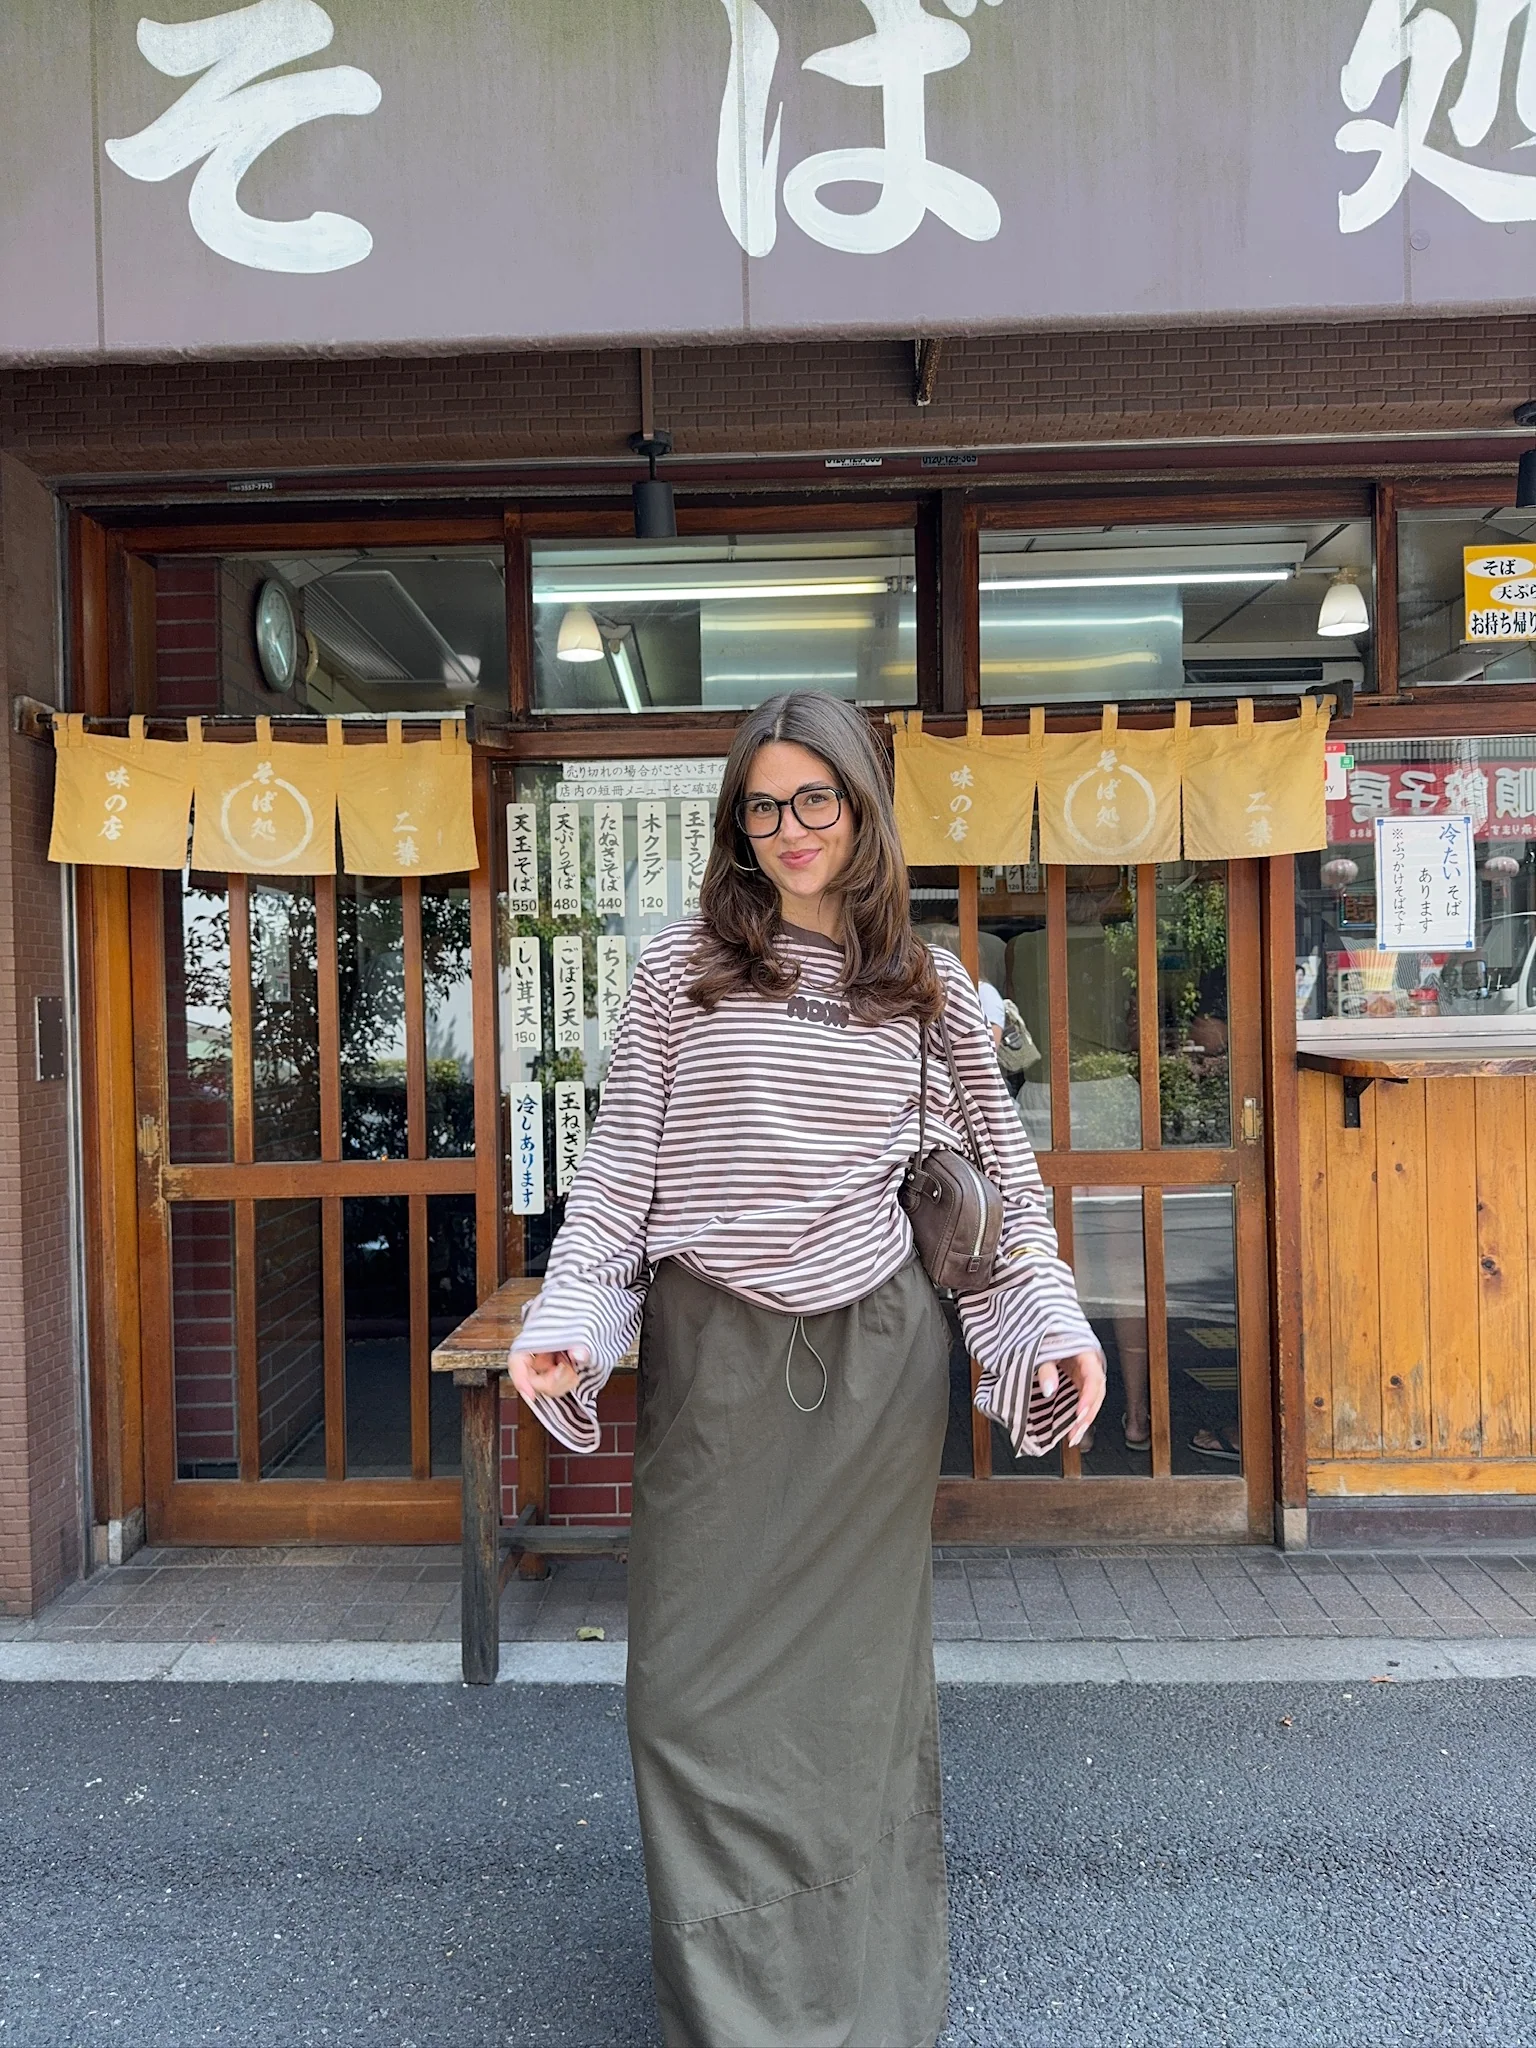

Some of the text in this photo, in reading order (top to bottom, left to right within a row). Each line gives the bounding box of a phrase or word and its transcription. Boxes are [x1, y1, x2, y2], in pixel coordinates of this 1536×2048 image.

[1483, 559, 1516, 576] そば
[97, 765, 130, 841] 味の店
[252, 761, 277, 841] そば処
[944, 764, 974, 841] 味の店
[1096, 749, 1121, 829] そば処
[512, 813, 535, 893] 天玉そば
[554, 813, 577, 890] 天ぷらそば
[598, 812, 622, 892] たぬきそば
[642, 813, 664, 885] 木クラゲ
[684, 810, 706, 890] 玉子うどん
[1438, 822, 1462, 917] 冷たいそば
[512, 899, 537, 912] 550
[553, 898, 578, 909] 480
[597, 897, 622, 909] 440
[641, 896, 664, 908] 120
[684, 896, 700, 909] 45
[1418, 867, 1433, 934] あります
[515, 947, 538, 1026] しい茸天
[558, 947, 580, 1027] ごぼう天
[602, 947, 621, 1026] ちくわ天
[514, 1030, 536, 1043] 150
[559, 1029, 580, 1042] 120
[603, 1030, 616, 1042] 15
[516, 1094, 538, 1209] 冷しあります
[559, 1092, 581, 1172] 玉ねぎ天
[560, 1175, 574, 1187] 12
